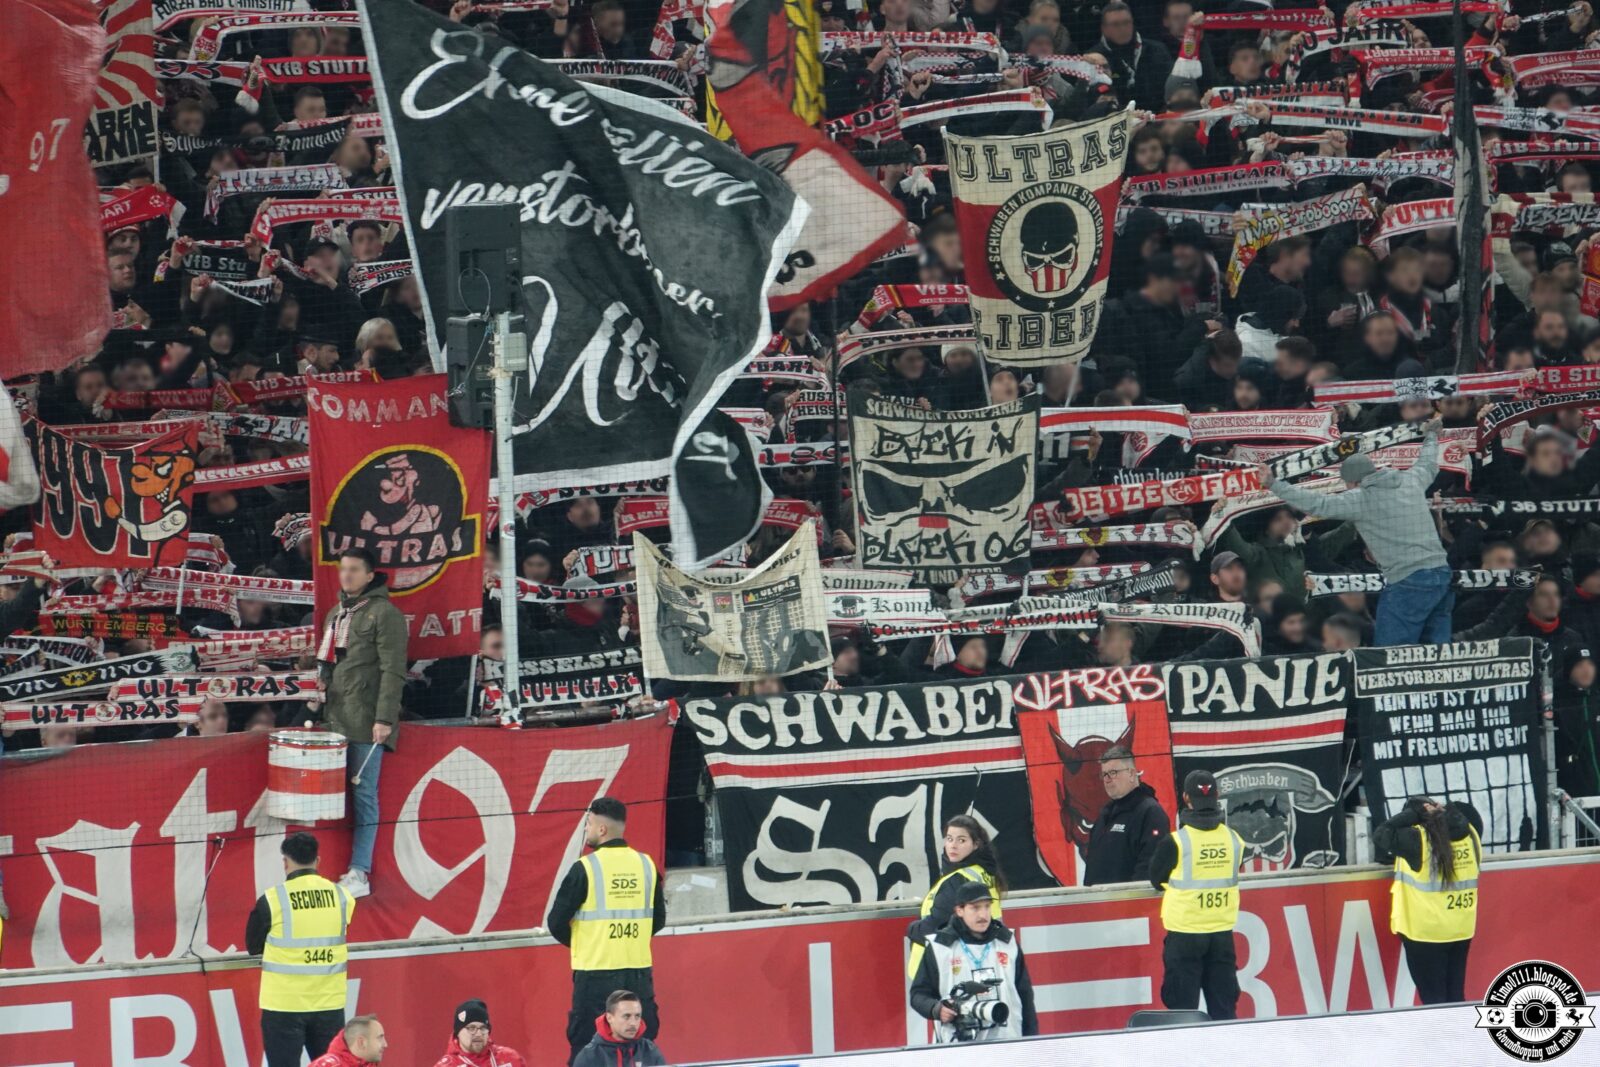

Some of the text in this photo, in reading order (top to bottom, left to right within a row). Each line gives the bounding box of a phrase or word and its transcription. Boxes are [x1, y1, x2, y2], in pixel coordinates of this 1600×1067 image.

[29, 117, 71, 174] 97
[950, 120, 1128, 184] ULTRAS
[988, 201, 1021, 264] SCHWABEN
[1018, 181, 1079, 205] KOMPANIE
[1078, 189, 1106, 249] STUTTGART
[1203, 469, 1262, 495] FAN
[1386, 638, 1500, 665] EHRE ALLEN
[1012, 663, 1166, 712] ULTRAS
[1356, 661, 1531, 691] VERSTORBENEN ULTRAS
[684, 680, 1019, 750] SCHWABEN
[1389, 713, 1434, 735] WENN
[1439, 709, 1476, 731] MAN
[1373, 724, 1529, 760] MIT FREUNDEN GEHT
[1220, 770, 1290, 794] Schwaben
[1199, 848, 1228, 860] SDS
[1454, 848, 1470, 861] DS
[611, 878, 638, 890] SDS
[289, 886, 336, 911] SECURITY
[1197, 891, 1229, 909] 1851
[1447, 892, 1474, 910] 2455
[609, 922, 639, 940] 2048
[303, 948, 334, 965] 3446
